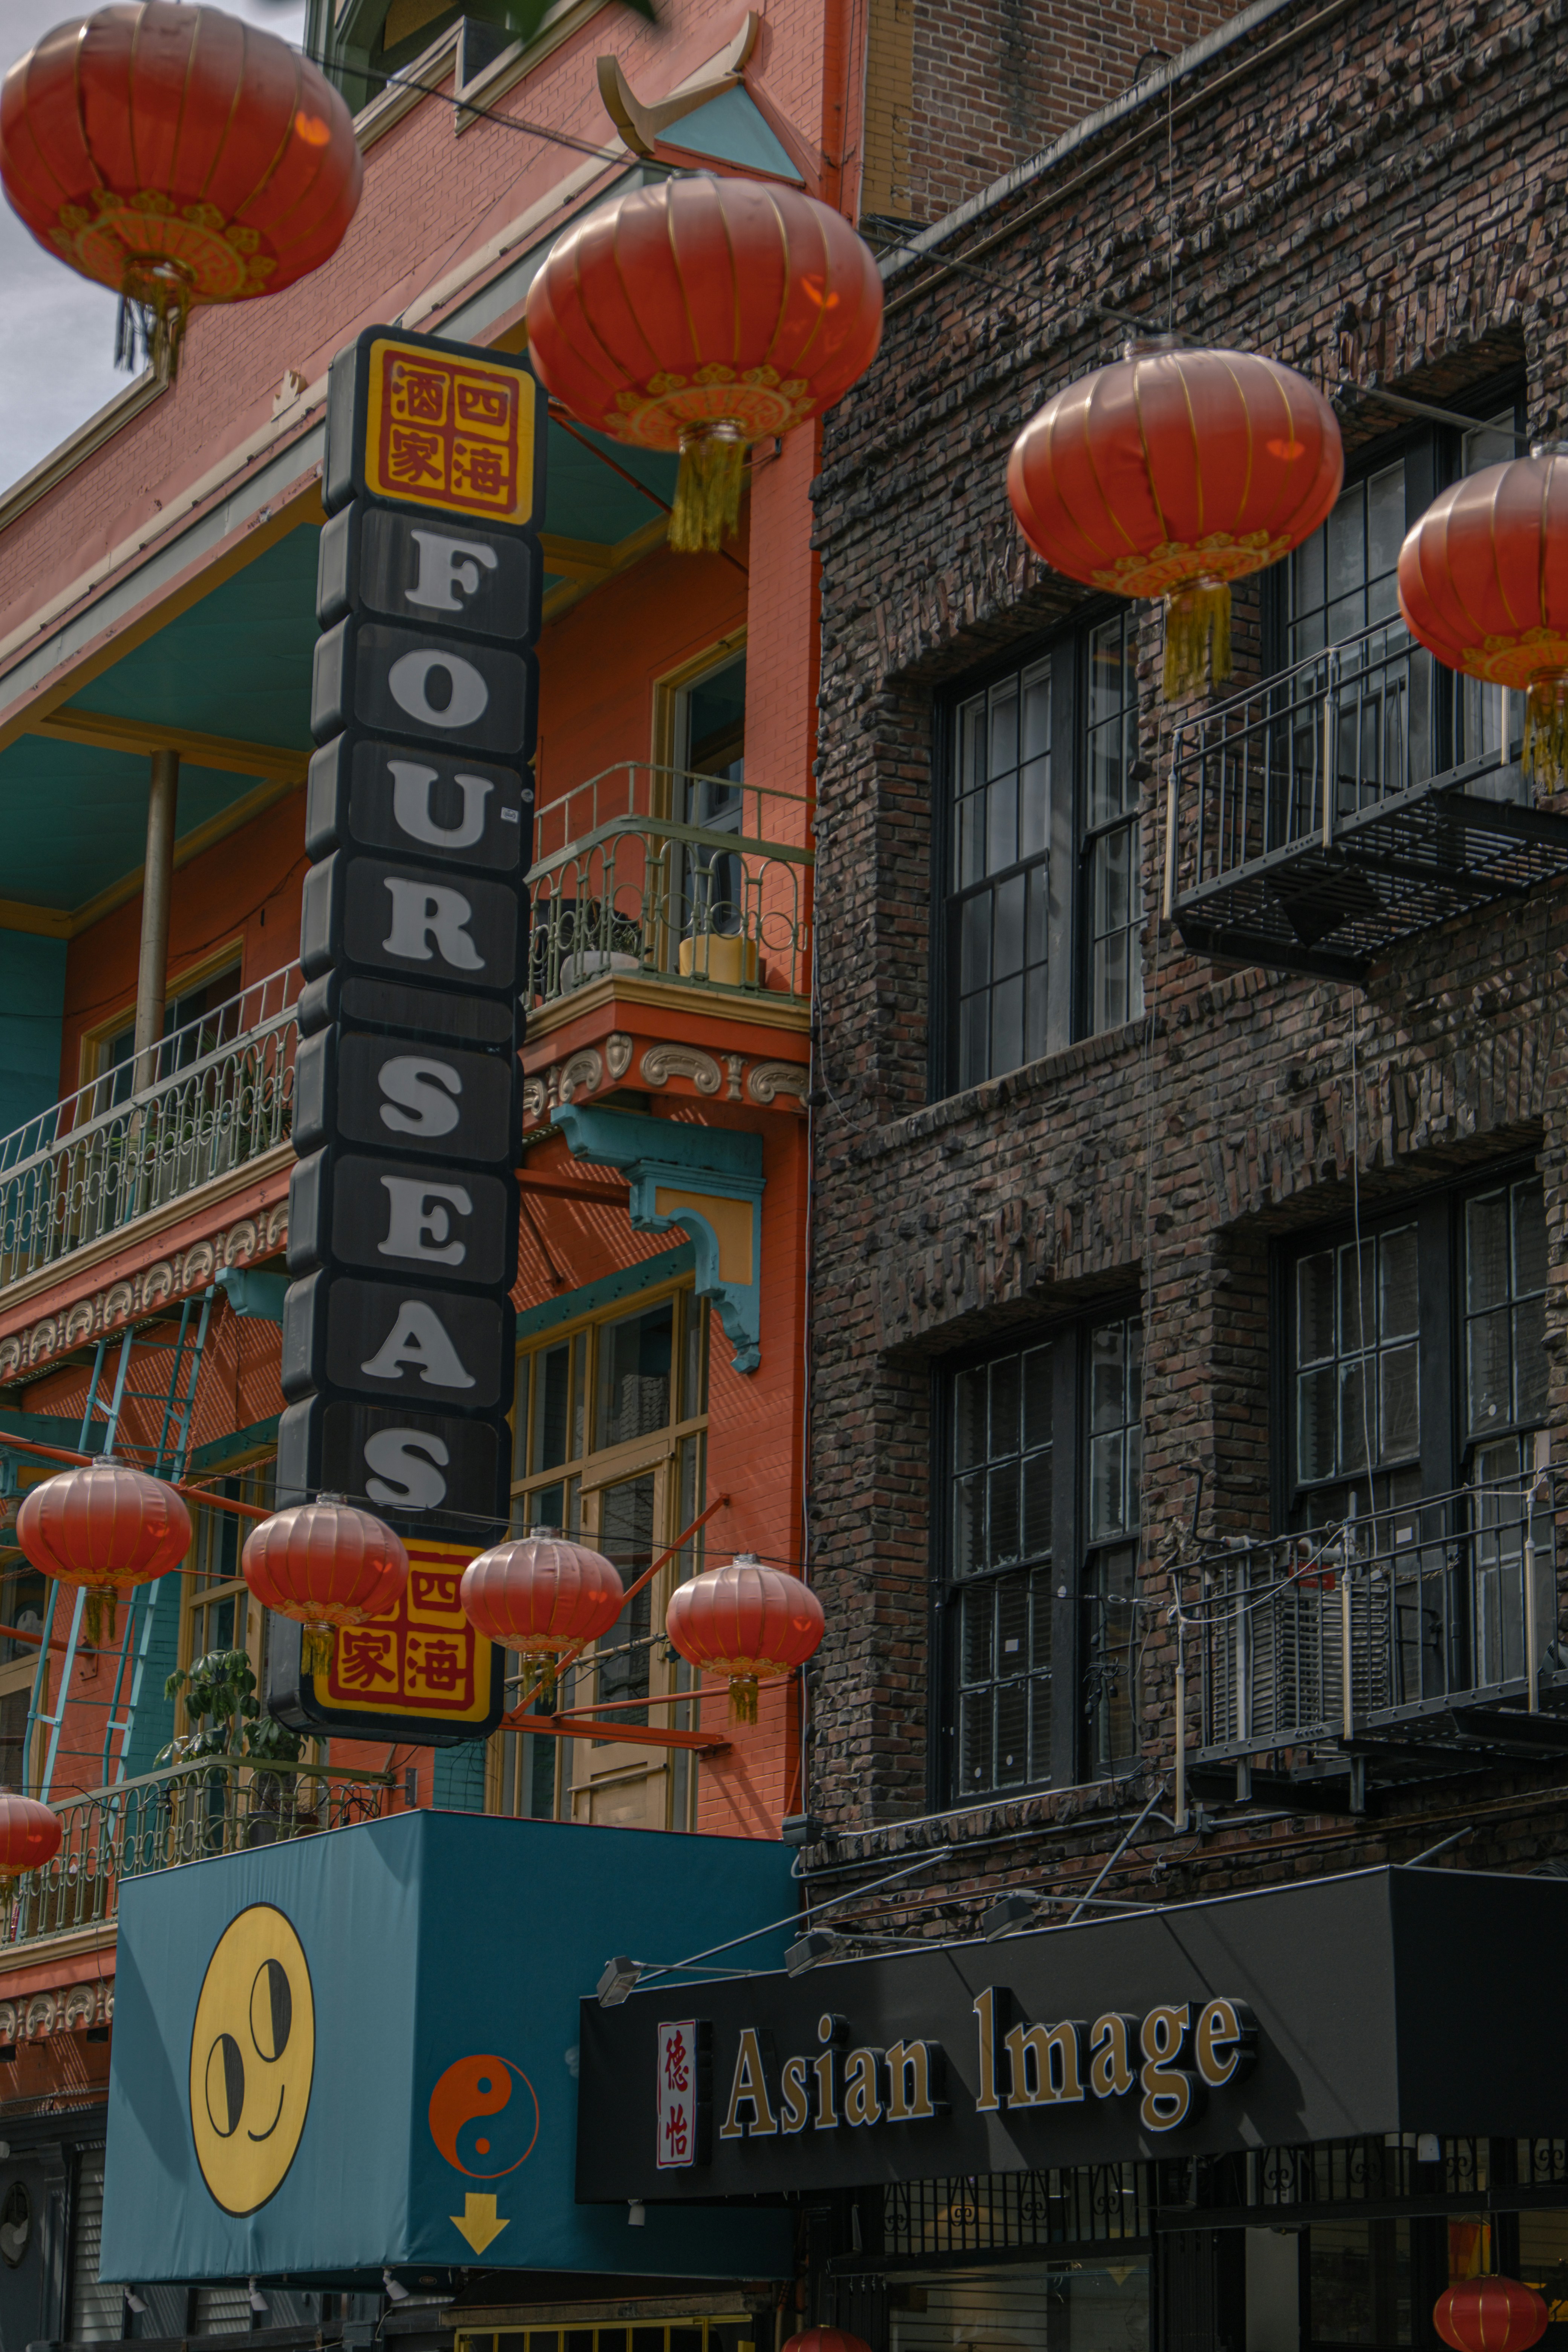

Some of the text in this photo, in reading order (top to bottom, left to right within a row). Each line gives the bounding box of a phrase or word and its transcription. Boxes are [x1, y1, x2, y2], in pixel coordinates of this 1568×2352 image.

[360, 529, 498, 1511] FOUR SEAS
[720, 1986, 1243, 2139] Asian Image
